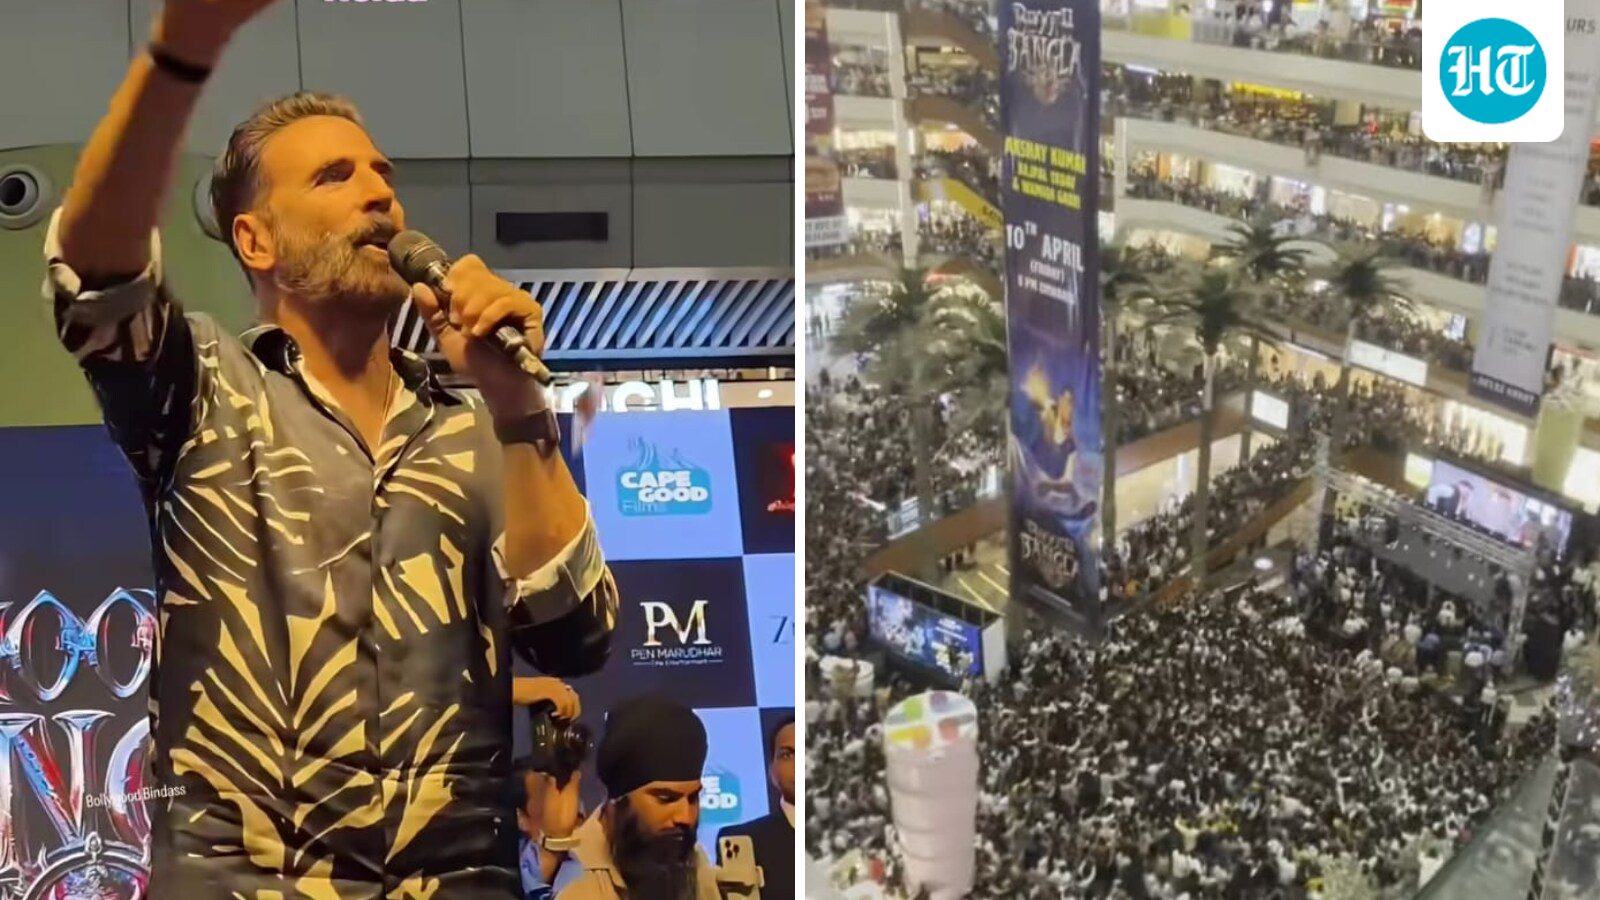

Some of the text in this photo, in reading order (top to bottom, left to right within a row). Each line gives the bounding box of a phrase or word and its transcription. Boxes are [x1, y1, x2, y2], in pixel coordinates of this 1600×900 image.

[1042, 234, 1085, 273] APRIL
[620, 470, 692, 489] CAPE
[638, 486, 709, 502] GOOD
